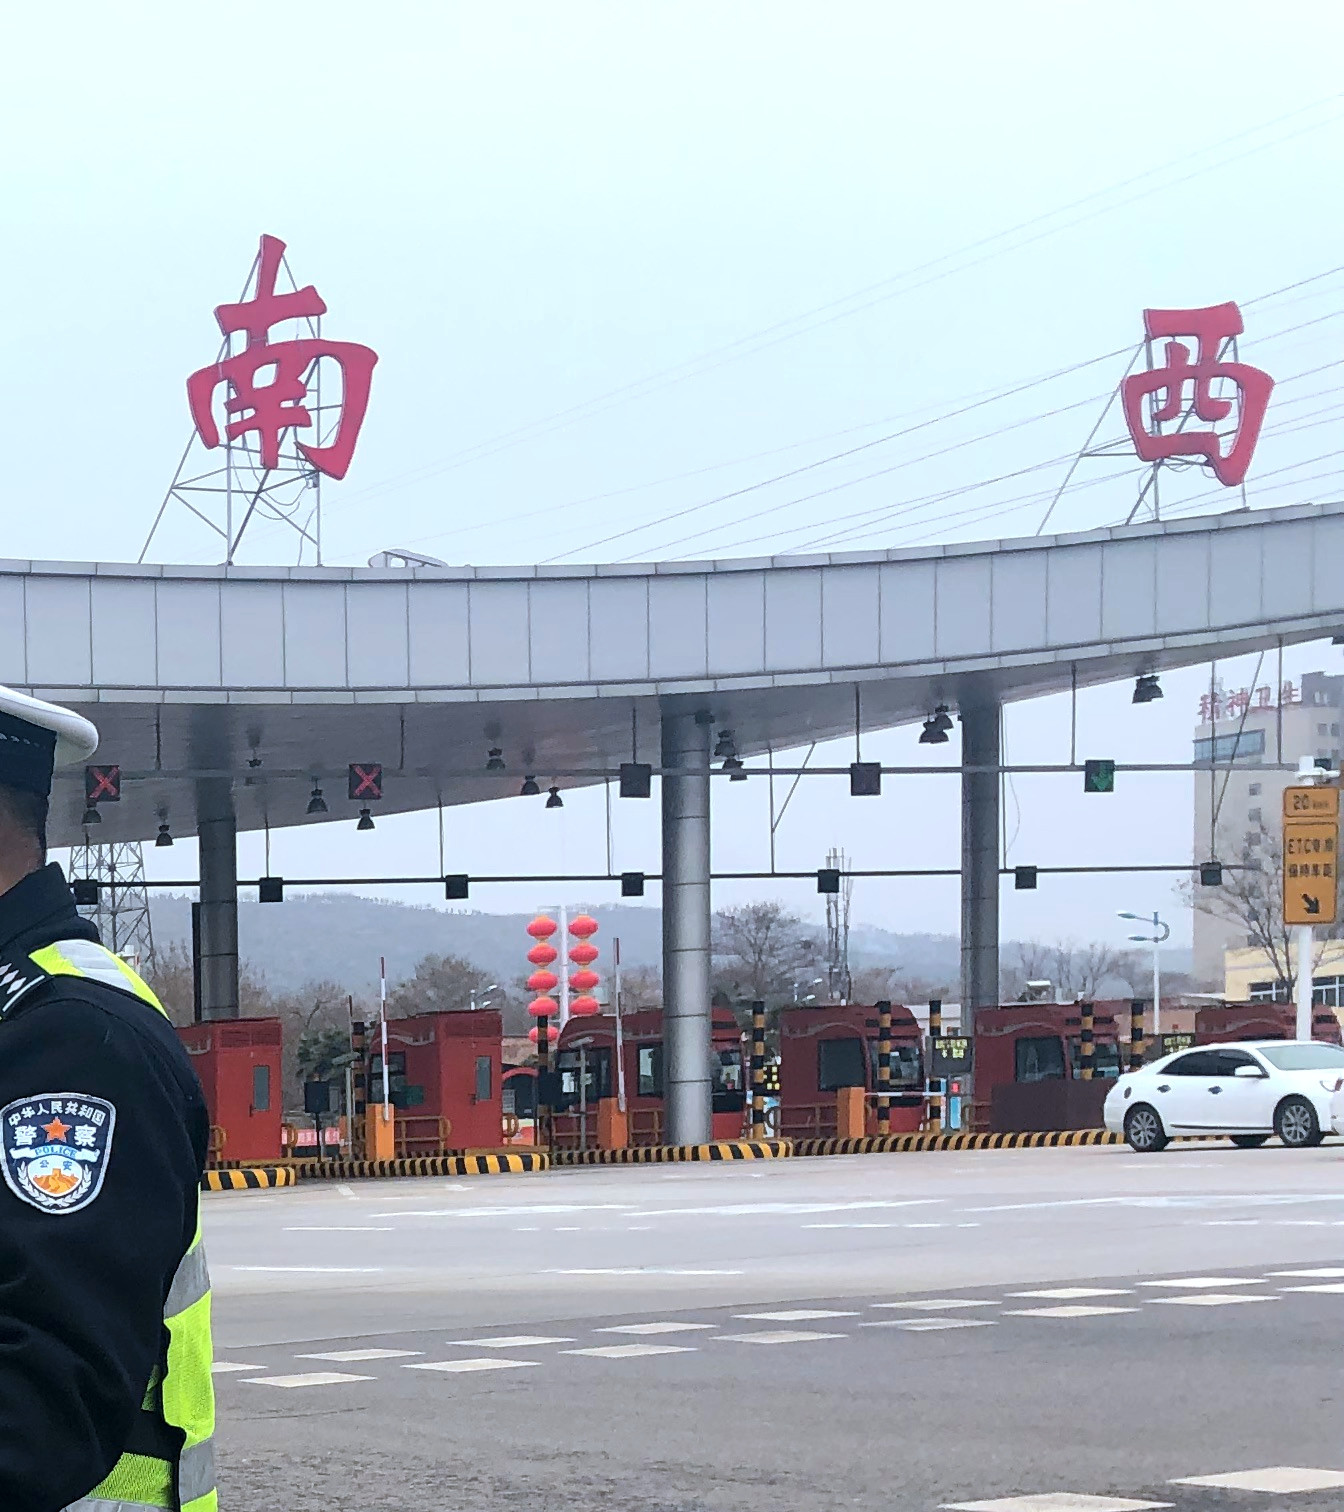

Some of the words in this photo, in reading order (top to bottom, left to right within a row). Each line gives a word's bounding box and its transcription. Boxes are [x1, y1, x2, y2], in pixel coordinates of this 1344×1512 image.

[185, 233, 379, 481] 南
[1120, 300, 1275, 487] 西
[8, 1101, 106, 1127] 中华人民共和国
[34, 1145, 78, 1159] POLICE
